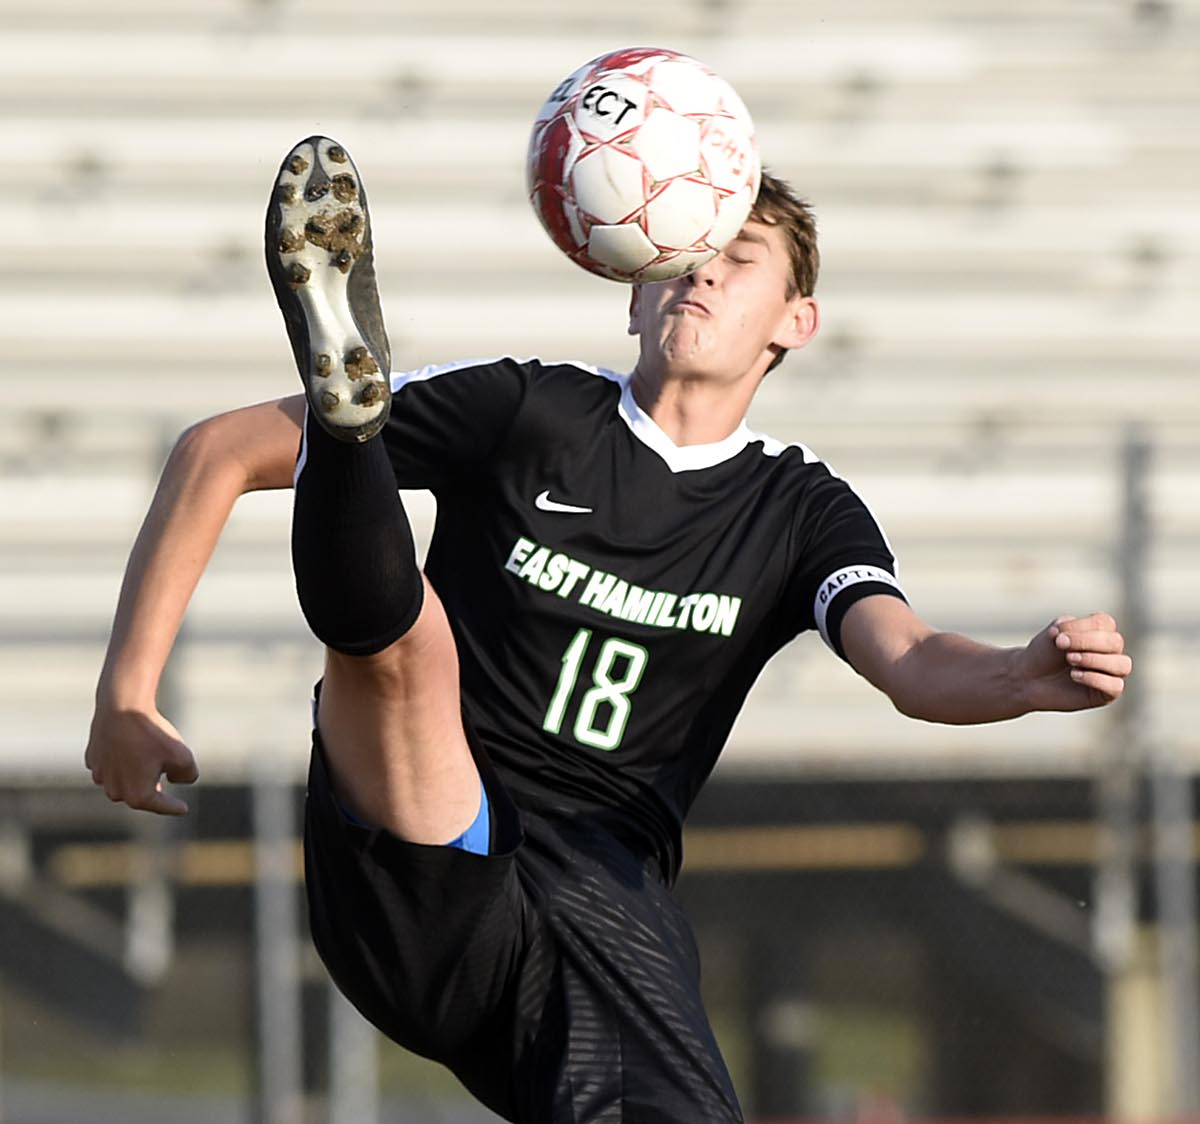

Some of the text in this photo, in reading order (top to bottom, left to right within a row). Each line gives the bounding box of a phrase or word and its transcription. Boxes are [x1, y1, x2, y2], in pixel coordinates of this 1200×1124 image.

[504, 536, 742, 637] EAST HAMILTON
[543, 627, 649, 751] 18
